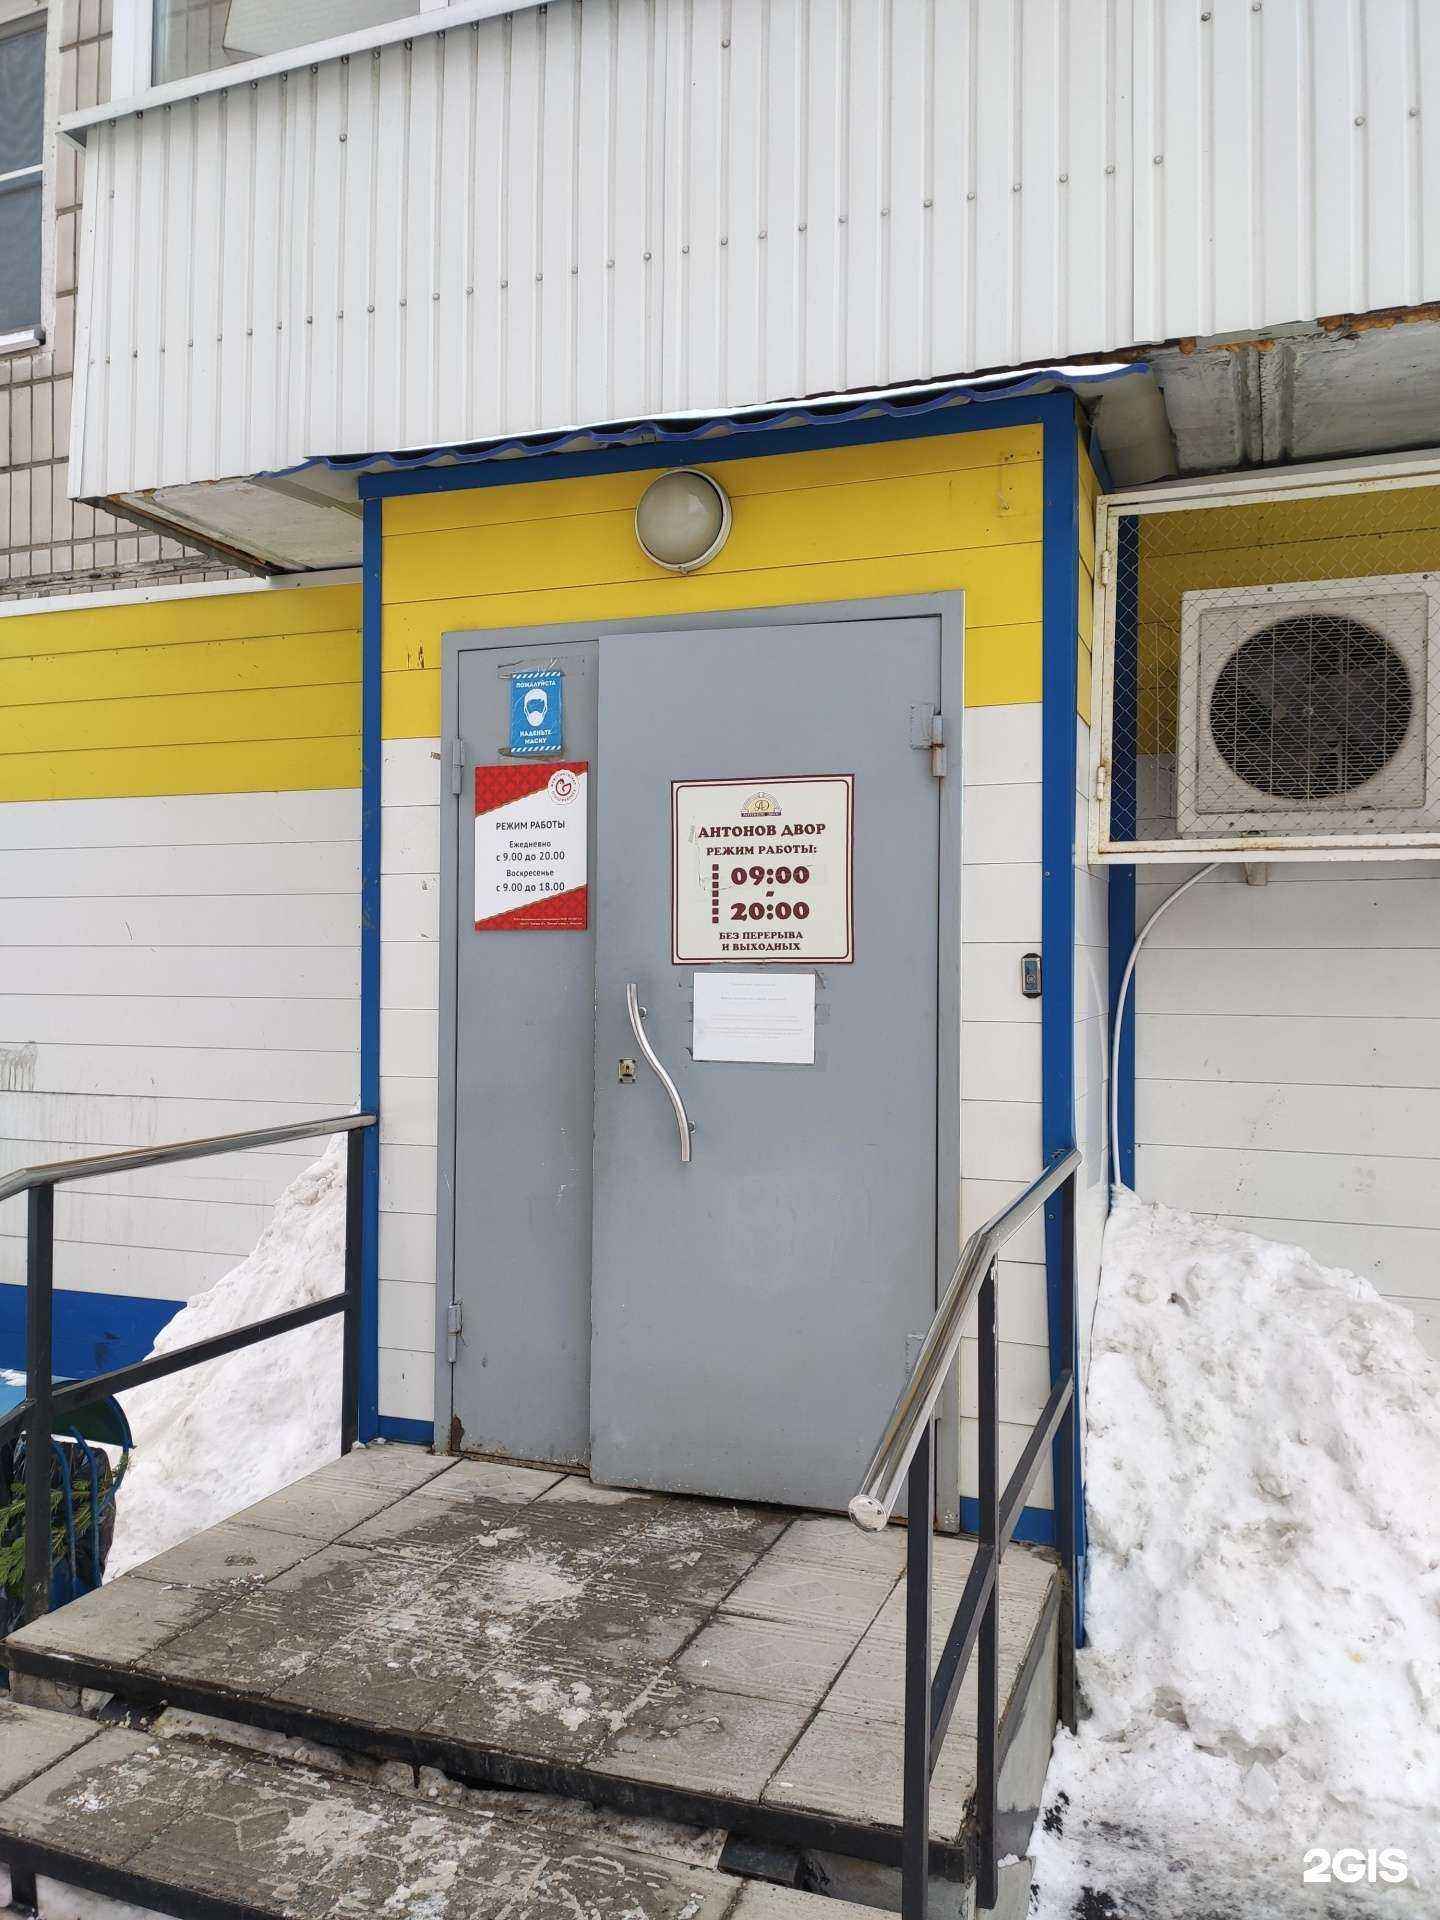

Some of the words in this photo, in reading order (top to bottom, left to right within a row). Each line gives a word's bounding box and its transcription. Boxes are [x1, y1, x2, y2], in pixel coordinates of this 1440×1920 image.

[516, 680, 556, 688] ПОЖАЛУЙСТА
[520, 729, 552, 737] НАДЕНЬТЕ
[495, 821, 528, 831] РЕЖИМ
[530, 820, 565, 830] РАБОТЫ
[698, 825, 777, 838] АНТОНОВ
[781, 824, 826, 837] ДВОР
[509, 840, 552, 849] Ежедневно
[706, 846, 755, 856] РЕЖИМ
[758, 845, 817, 855] РАБОТЫ:
[503, 852, 523, 862] 9.00
[525, 854, 537, 863] до
[539, 851, 565, 861] 20.00
[506, 869, 554, 879] Воскресенье
[731, 866, 810, 885] 09:00
[503, 882, 523, 892] 9.00
[525, 884, 536, 893] до
[539, 882, 565, 892] 18.00
[730, 902, 810, 921] 20:00
[719, 932, 740, 940] БЕЗ
[742, 931, 803, 940] ПЕРЕРЫВА
[722, 943, 730, 951] И
[732, 942, 801, 951] ВЫХОДНЫХ
